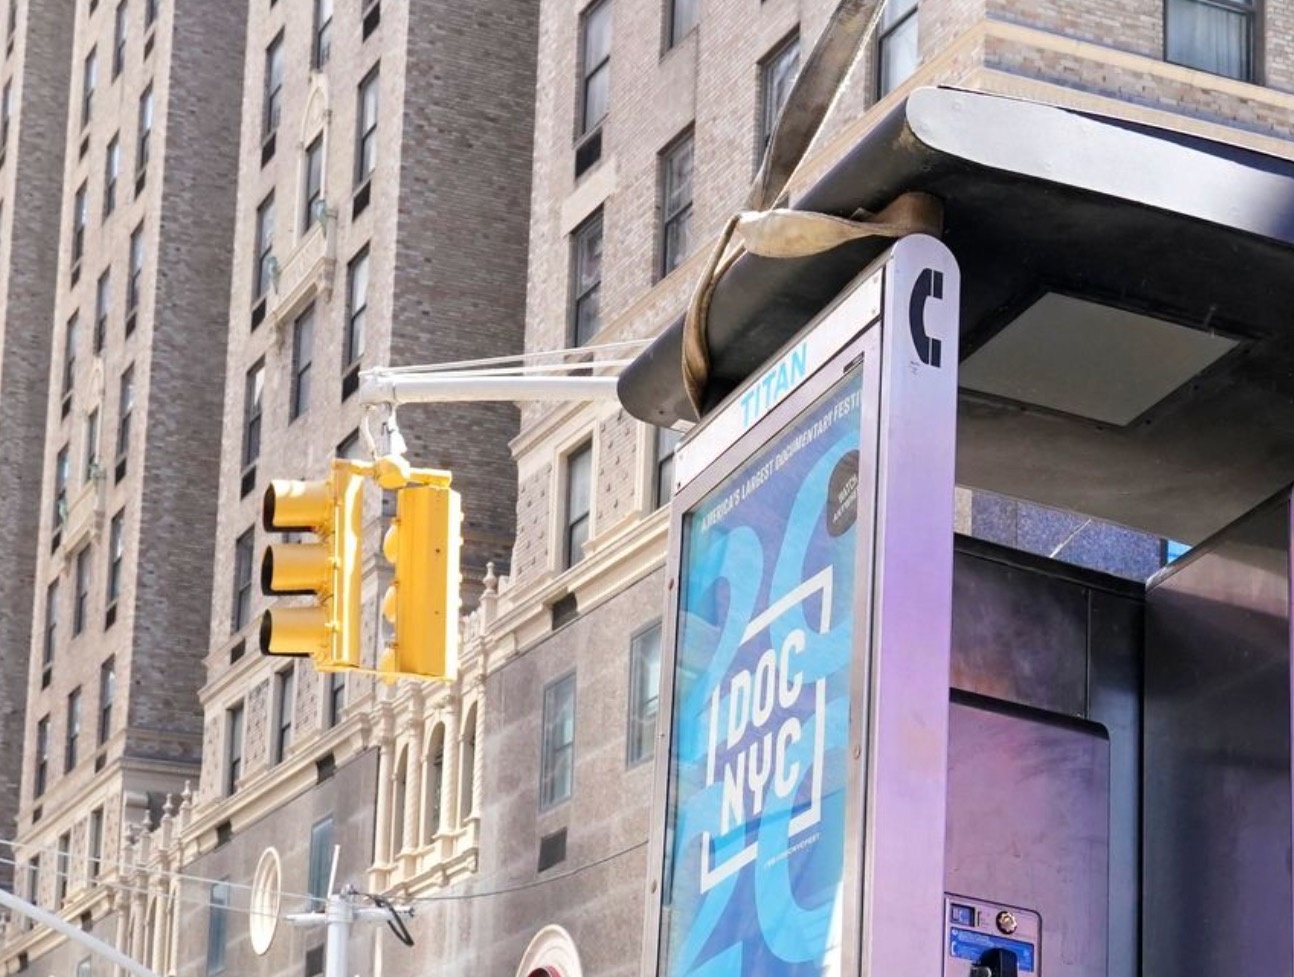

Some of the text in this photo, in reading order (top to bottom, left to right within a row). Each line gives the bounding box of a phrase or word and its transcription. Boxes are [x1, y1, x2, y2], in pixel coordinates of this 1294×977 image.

[740, 342, 807, 427] TITAN
[727, 629, 806, 750] DOC
[720, 716, 802, 837] NYC
